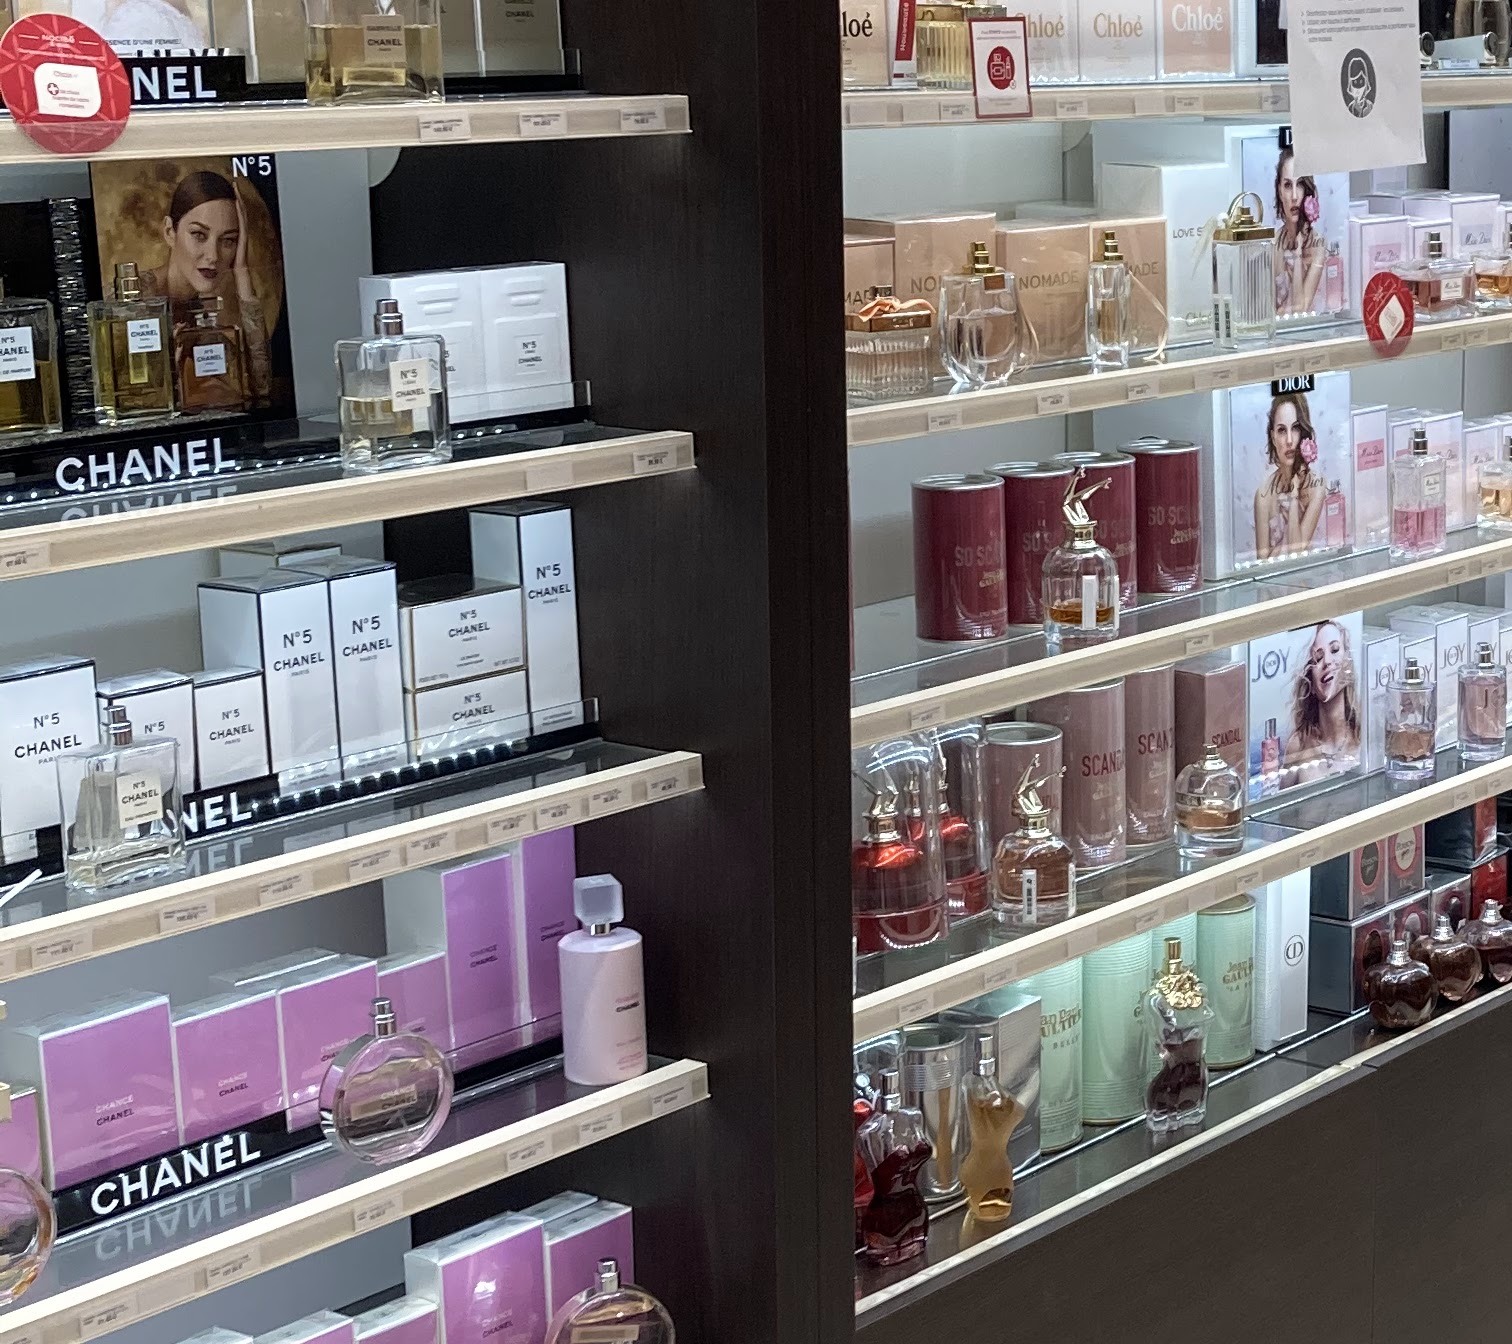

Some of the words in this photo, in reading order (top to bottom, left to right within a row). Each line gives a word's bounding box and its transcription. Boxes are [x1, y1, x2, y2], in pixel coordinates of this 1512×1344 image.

[504, 9, 535, 20] CHANEL
[841, 10, 874, 38] loé
[1171, 3, 1225, 33] Chloé
[1093, 12, 1144, 39] Chloé
[367, 37, 403, 48] CHANEL
[132, 64, 218, 100] NEL
[231, 156, 273, 178] N°5
[1172, 227, 1195, 239] LOVE
[1018, 270, 1080, 291] NOMADE
[130, 329, 160, 339] CHANEL
[196, 353, 224, 364] CHANEL
[518, 355, 543, 365] CHANEL
[395, 387, 427, 399] CHANEL
[1277, 375, 1311, 393] DIOR
[55, 437, 236, 492] CHANEL
[1298, 469, 1326, 491] Dior
[536, 562, 562, 581] N°5
[527, 583, 573, 601] CHANEL
[459, 609, 478, 621] N°5
[351, 615, 381, 635] N°5
[448, 621, 491, 639] CHANEL
[283, 629, 313, 649] N°5
[342, 637, 394, 658] CHANEL
[273, 651, 326, 672] CHANEL
[1251, 646, 1291, 684] JOY
[1439, 642, 1468, 670] JOY
[1372, 662, 1398, 690] JOY
[463, 692, 482, 704] N°5
[32, 712, 61, 730] N°5
[221, 707, 241, 721] N°5
[451, 704, 496, 723] CHANEL
[143, 719, 166, 735] N°5
[209, 723, 255, 742] CHANEL
[14, 734, 83, 760] CHANEL
[1211, 727, 1242, 749] SCANDAL
[121, 788, 160, 805] CHANEL
[181, 790, 253, 835] NEL
[218, 1082, 250, 1097] CHANEL
[96, 1094, 134, 1113] CHANCE
[96, 1108, 135, 1127] CHANEL
[90, 1130, 262, 1216] CHANEL
